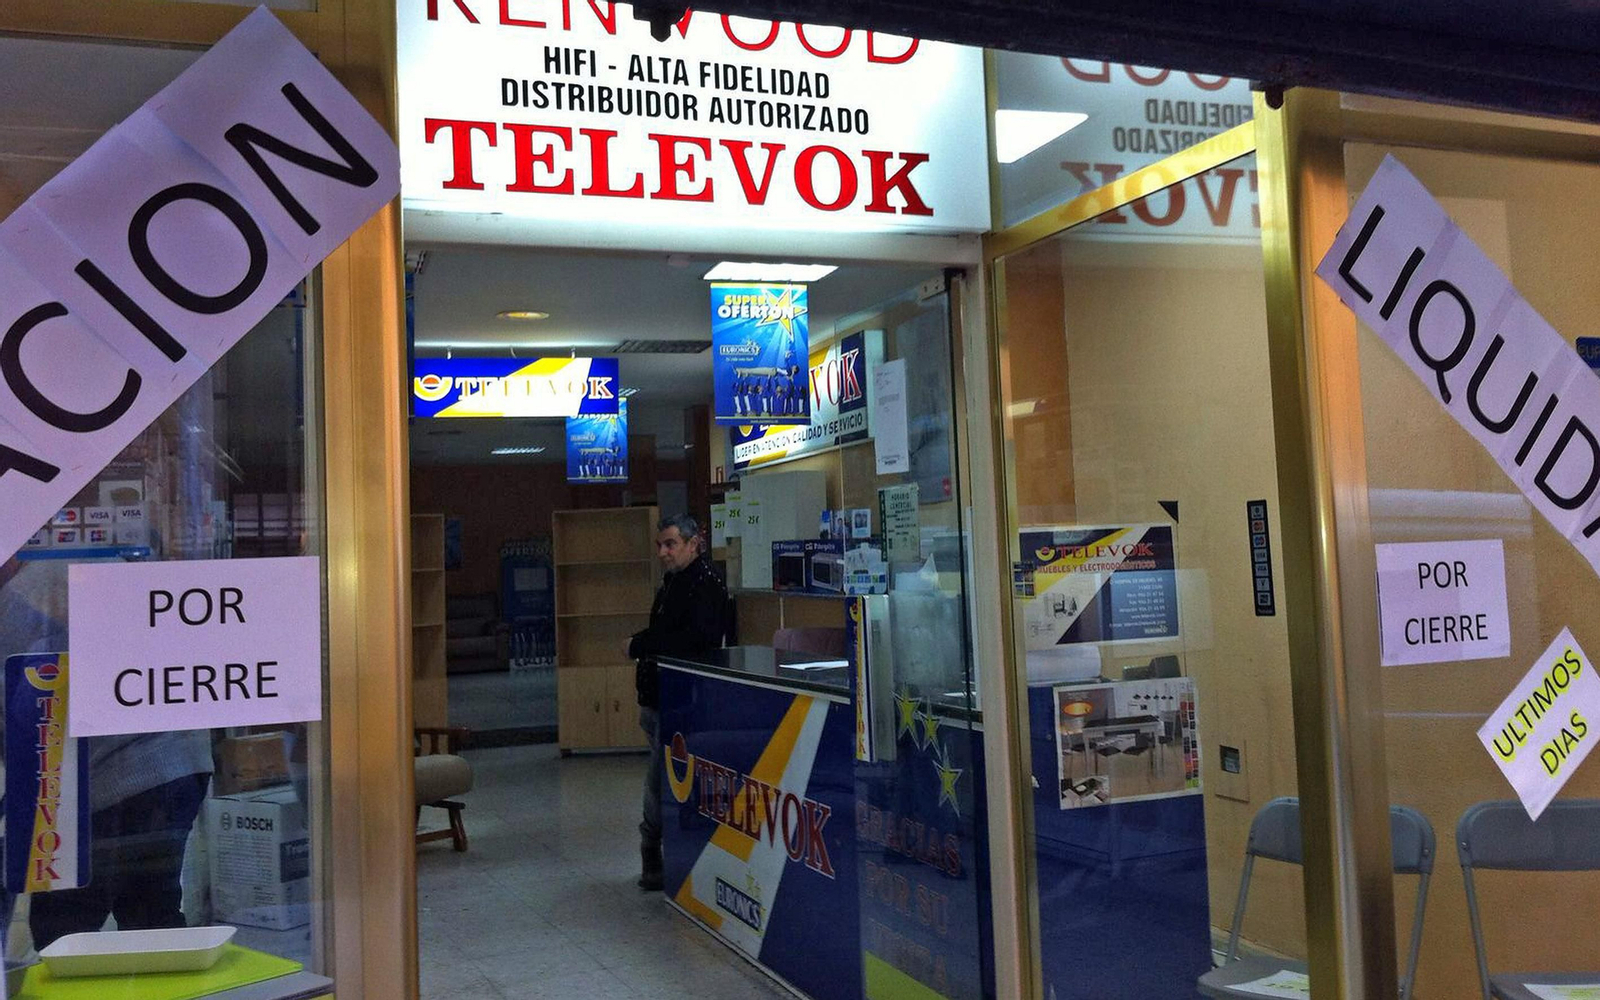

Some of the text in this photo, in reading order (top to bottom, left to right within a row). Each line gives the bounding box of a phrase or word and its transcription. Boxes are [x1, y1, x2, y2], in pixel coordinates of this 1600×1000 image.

[543, 46, 597, 77] HIFI
[628, 54, 689, 87] ALTA
[699, 62, 831, 99] FIDELIDAD
[501, 78, 870, 135] DISTRIBUIDOR AUTORIZADO
[424, 117, 934, 217] TELEVOK
[1338, 204, 1600, 540] LIQUID
[793, 427, 822, 443] CALIDAD
[122, 509, 142, 518] VISA
[1057, 543, 1154, 562] TELEVOK
[1417, 561, 1469, 589] POR
[149, 587, 246, 628] POR
[1404, 614, 1489, 646] CIERRE
[114, 661, 279, 707] CIERRE
[1493, 649, 1582, 758] ULTIMOS
[1540, 712, 1588, 775] DIAS
[35, 696, 62, 882] TELEVOK
[236, 816, 273, 832] BOSCH
[694, 755, 836, 880] TELEVOK
